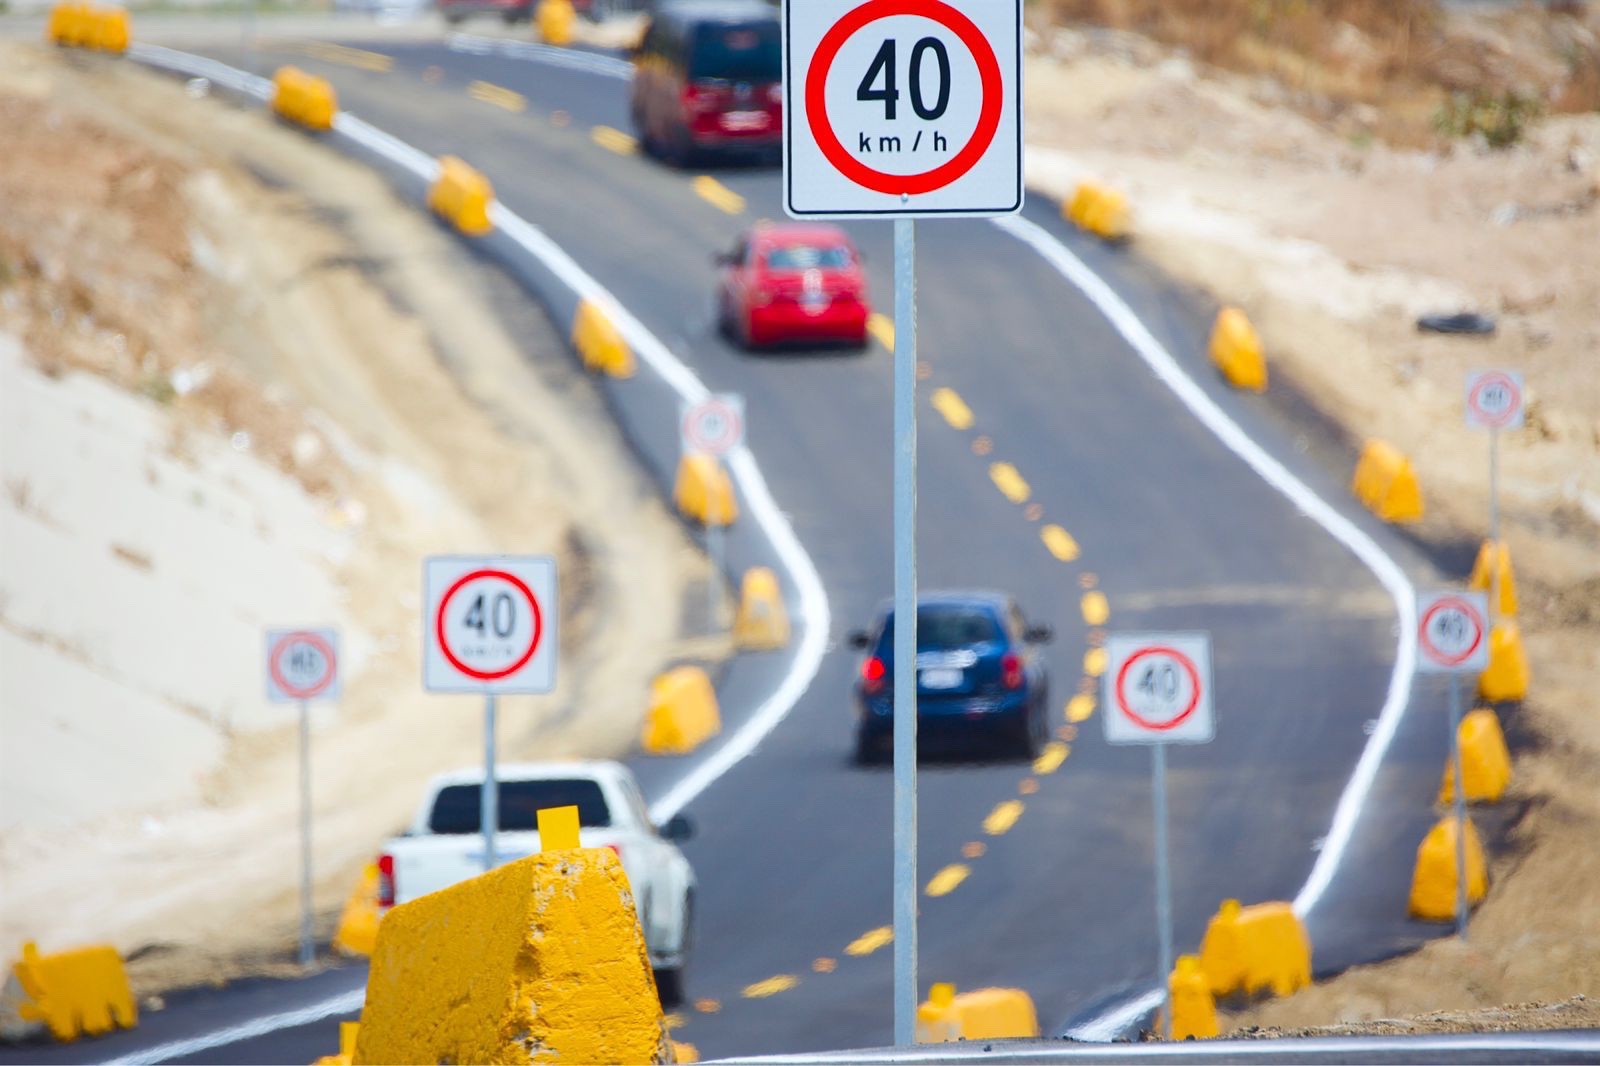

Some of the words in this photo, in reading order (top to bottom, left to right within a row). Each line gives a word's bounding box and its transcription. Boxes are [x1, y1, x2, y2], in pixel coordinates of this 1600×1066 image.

[857, 36, 951, 121] 40
[463, 592, 516, 638] 40
[1136, 664, 1178, 702] 40
